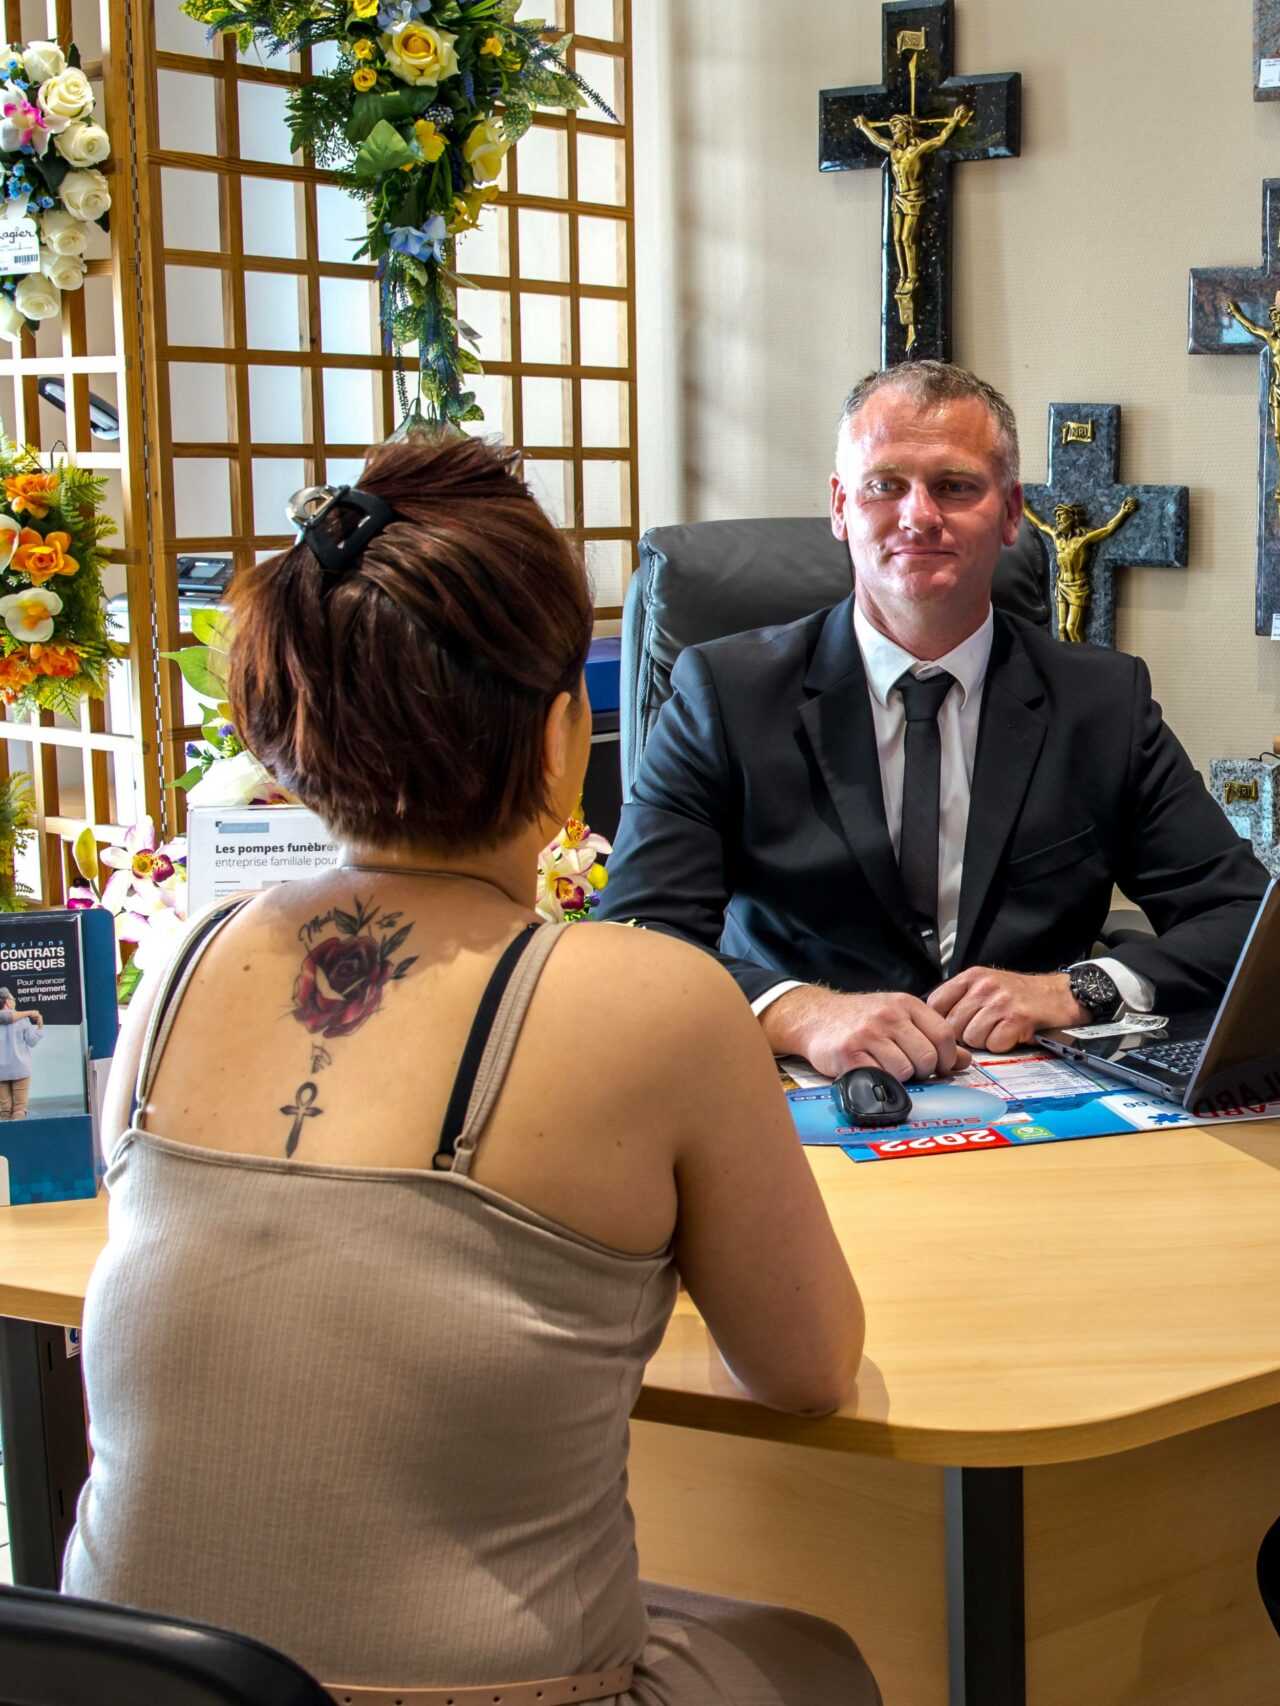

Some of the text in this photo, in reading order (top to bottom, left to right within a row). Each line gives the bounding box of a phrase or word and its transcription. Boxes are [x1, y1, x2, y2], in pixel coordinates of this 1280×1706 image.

[215, 844, 235, 854] Les
[238, 845, 285, 855] pompes
[215, 856, 338, 868] entreprise familiale pour
[0, 946, 65, 960] CONTRATS
[18, 995, 37, 1003] vers
[879, 1129, 997, 1152] 2022
